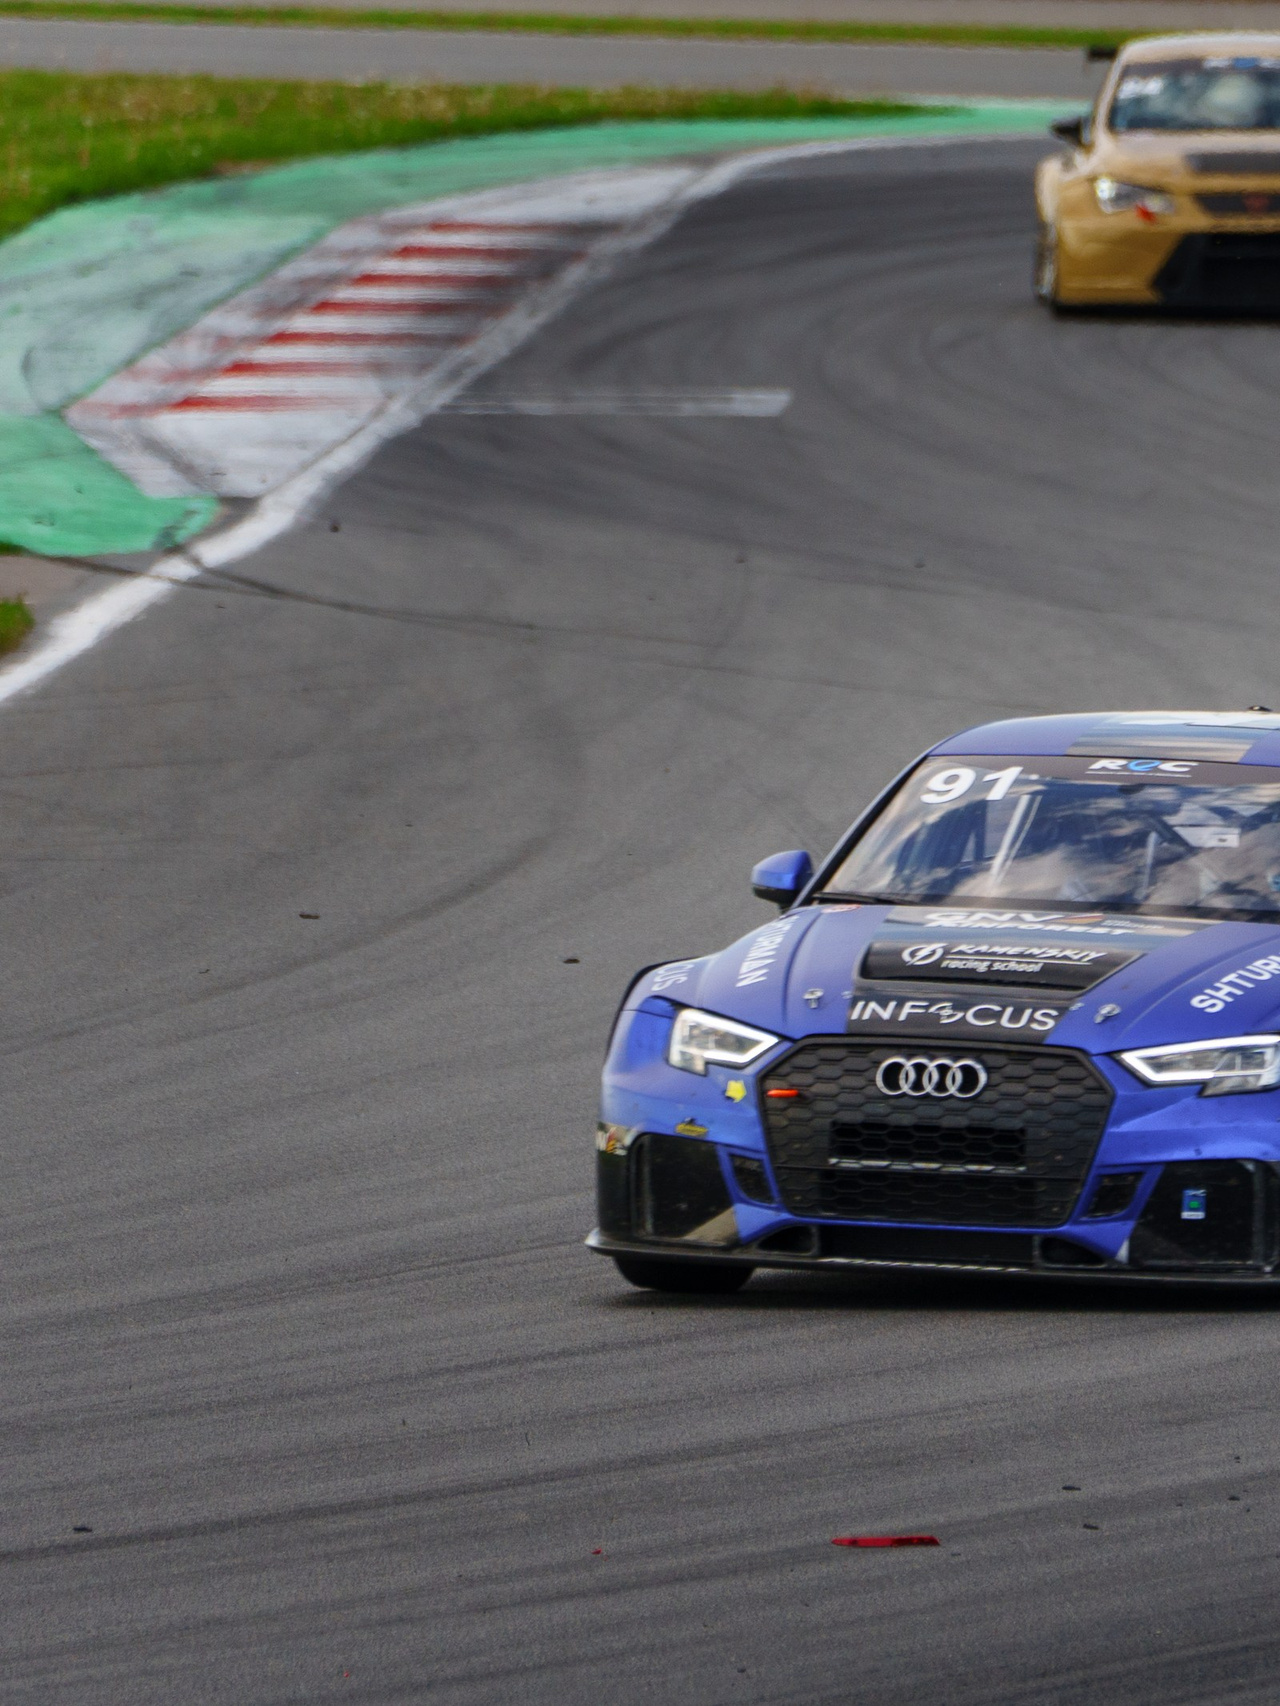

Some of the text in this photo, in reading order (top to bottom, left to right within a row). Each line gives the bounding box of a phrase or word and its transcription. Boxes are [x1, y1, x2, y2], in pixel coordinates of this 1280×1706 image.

[920, 766, 1024, 804] 91
[950, 944, 1108, 961] KAMENSKIY
[940, 959, 1044, 973] racing school
